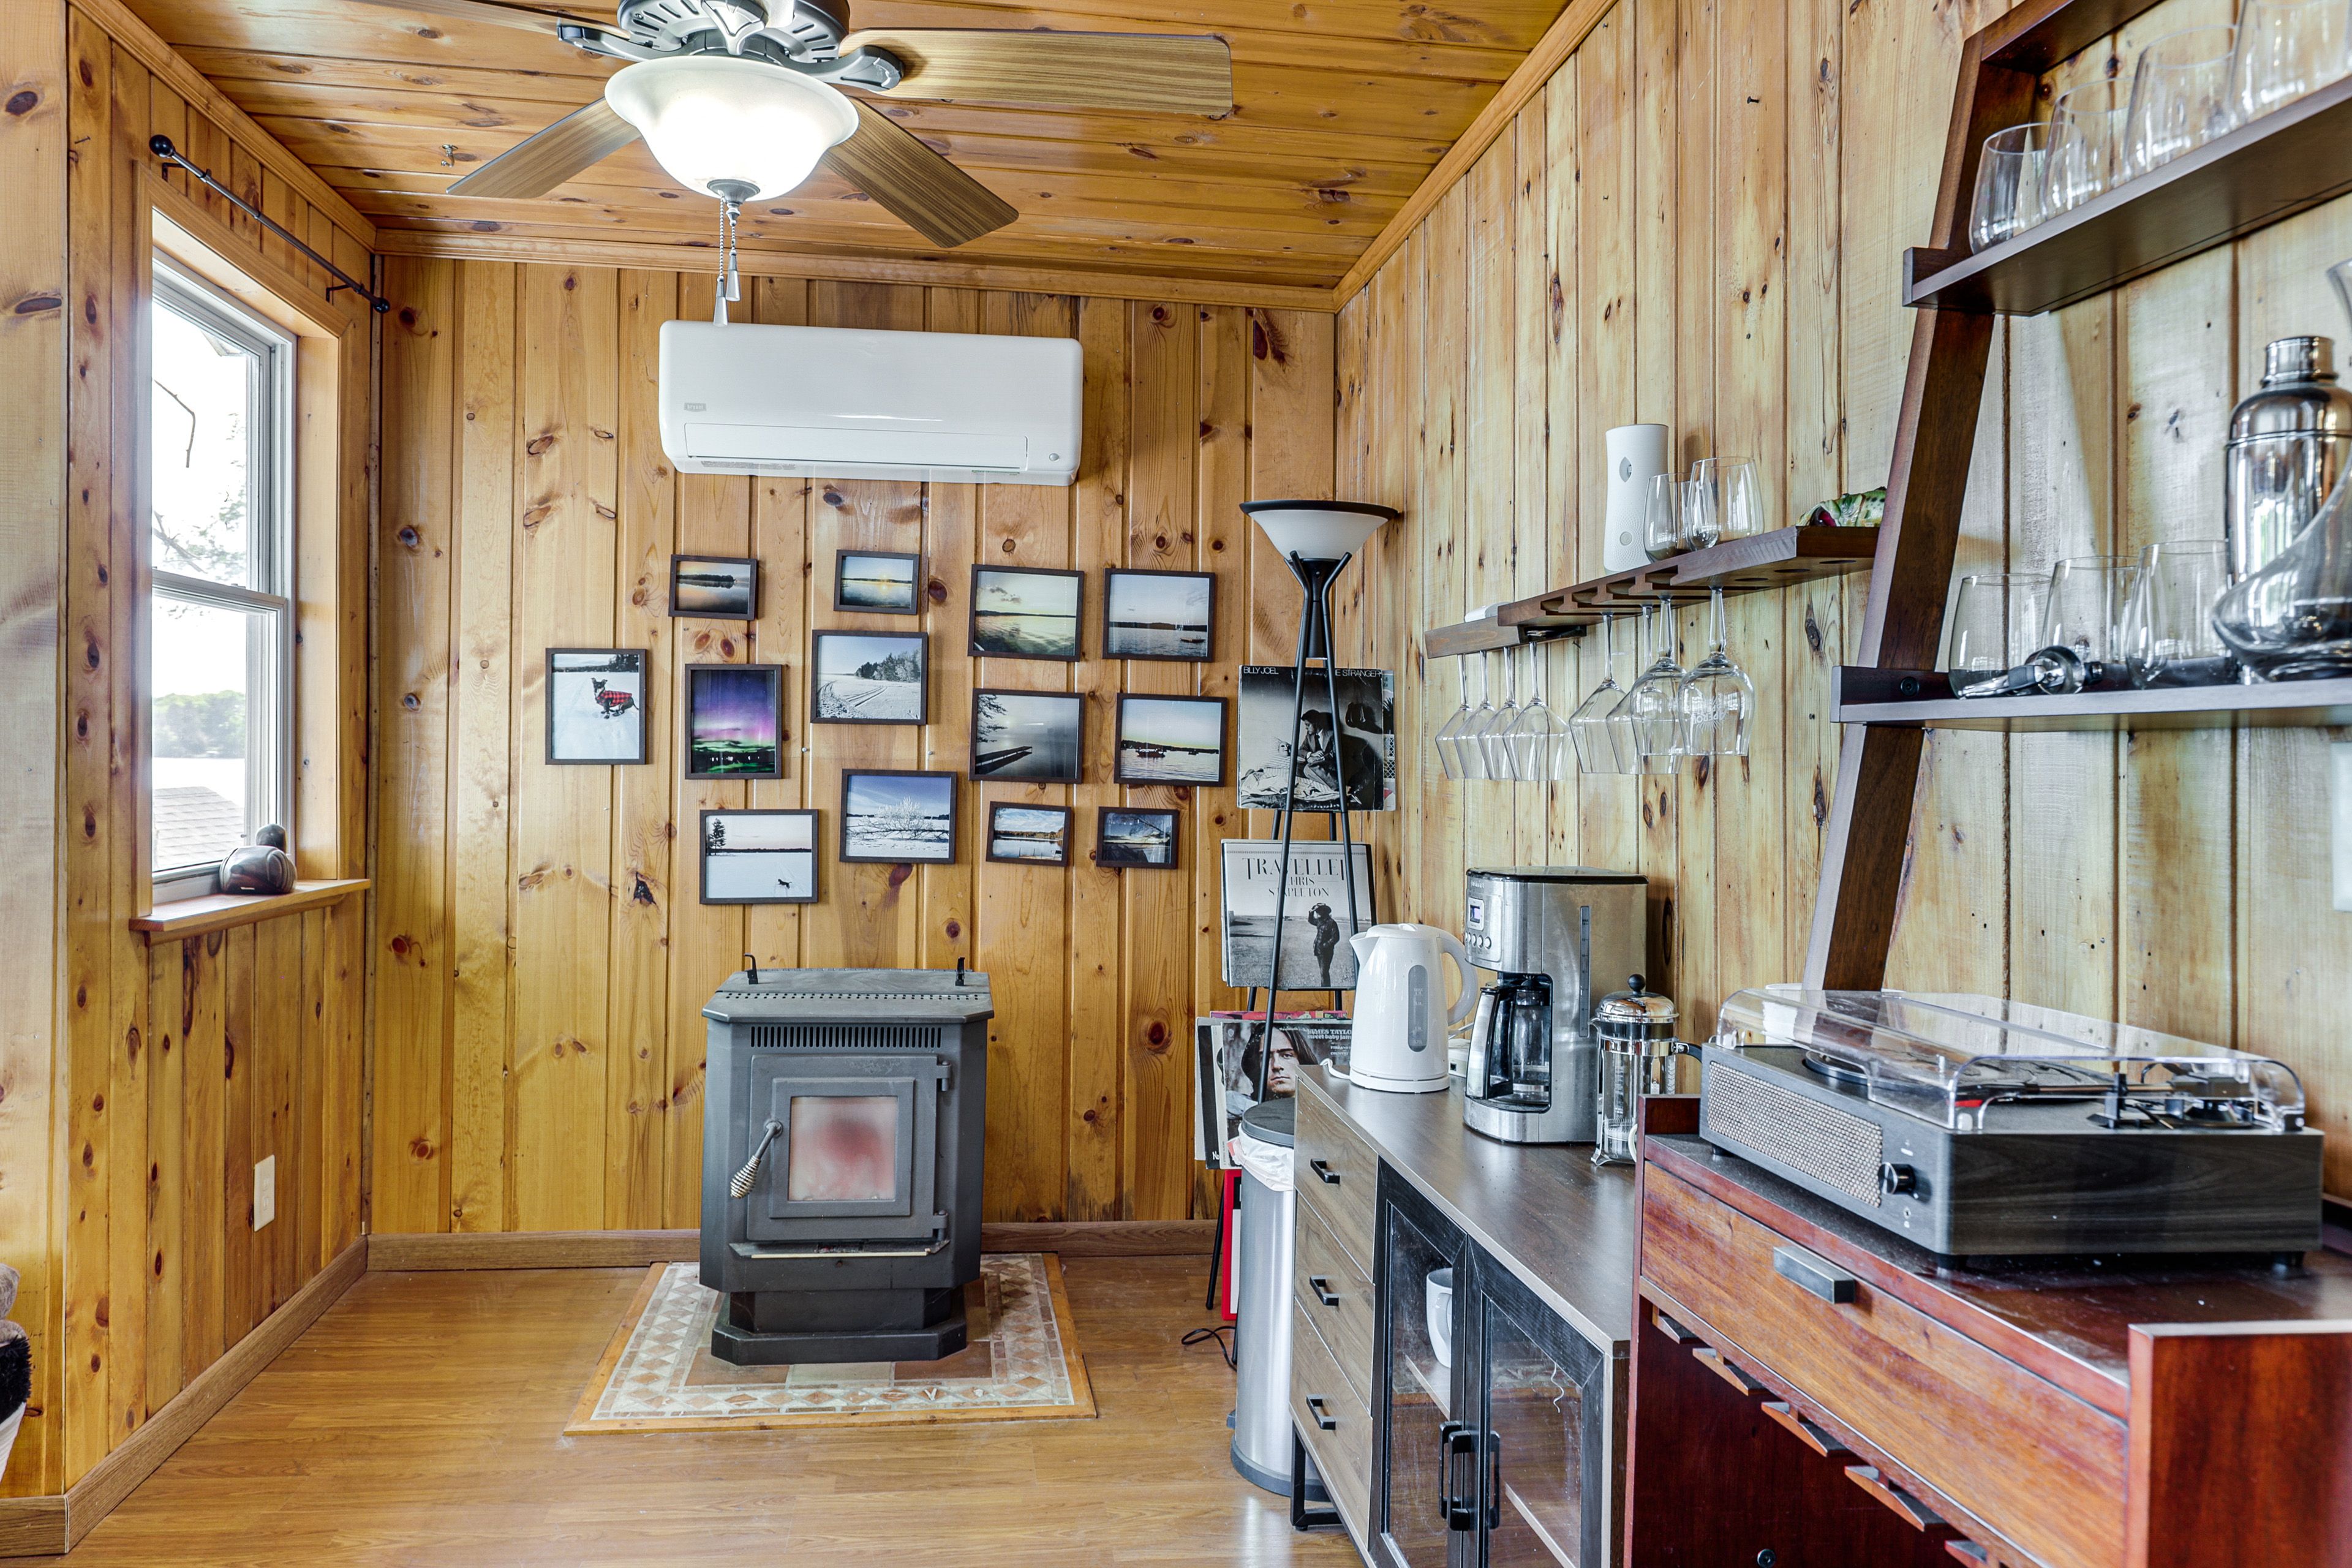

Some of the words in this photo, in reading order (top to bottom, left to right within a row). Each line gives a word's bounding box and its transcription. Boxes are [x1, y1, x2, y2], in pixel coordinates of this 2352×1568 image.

[1342, 669, 1382, 677] STRANGER
[1289, 876, 1315, 886] HRIS
[1268, 888, 1329, 897] SPLETON
